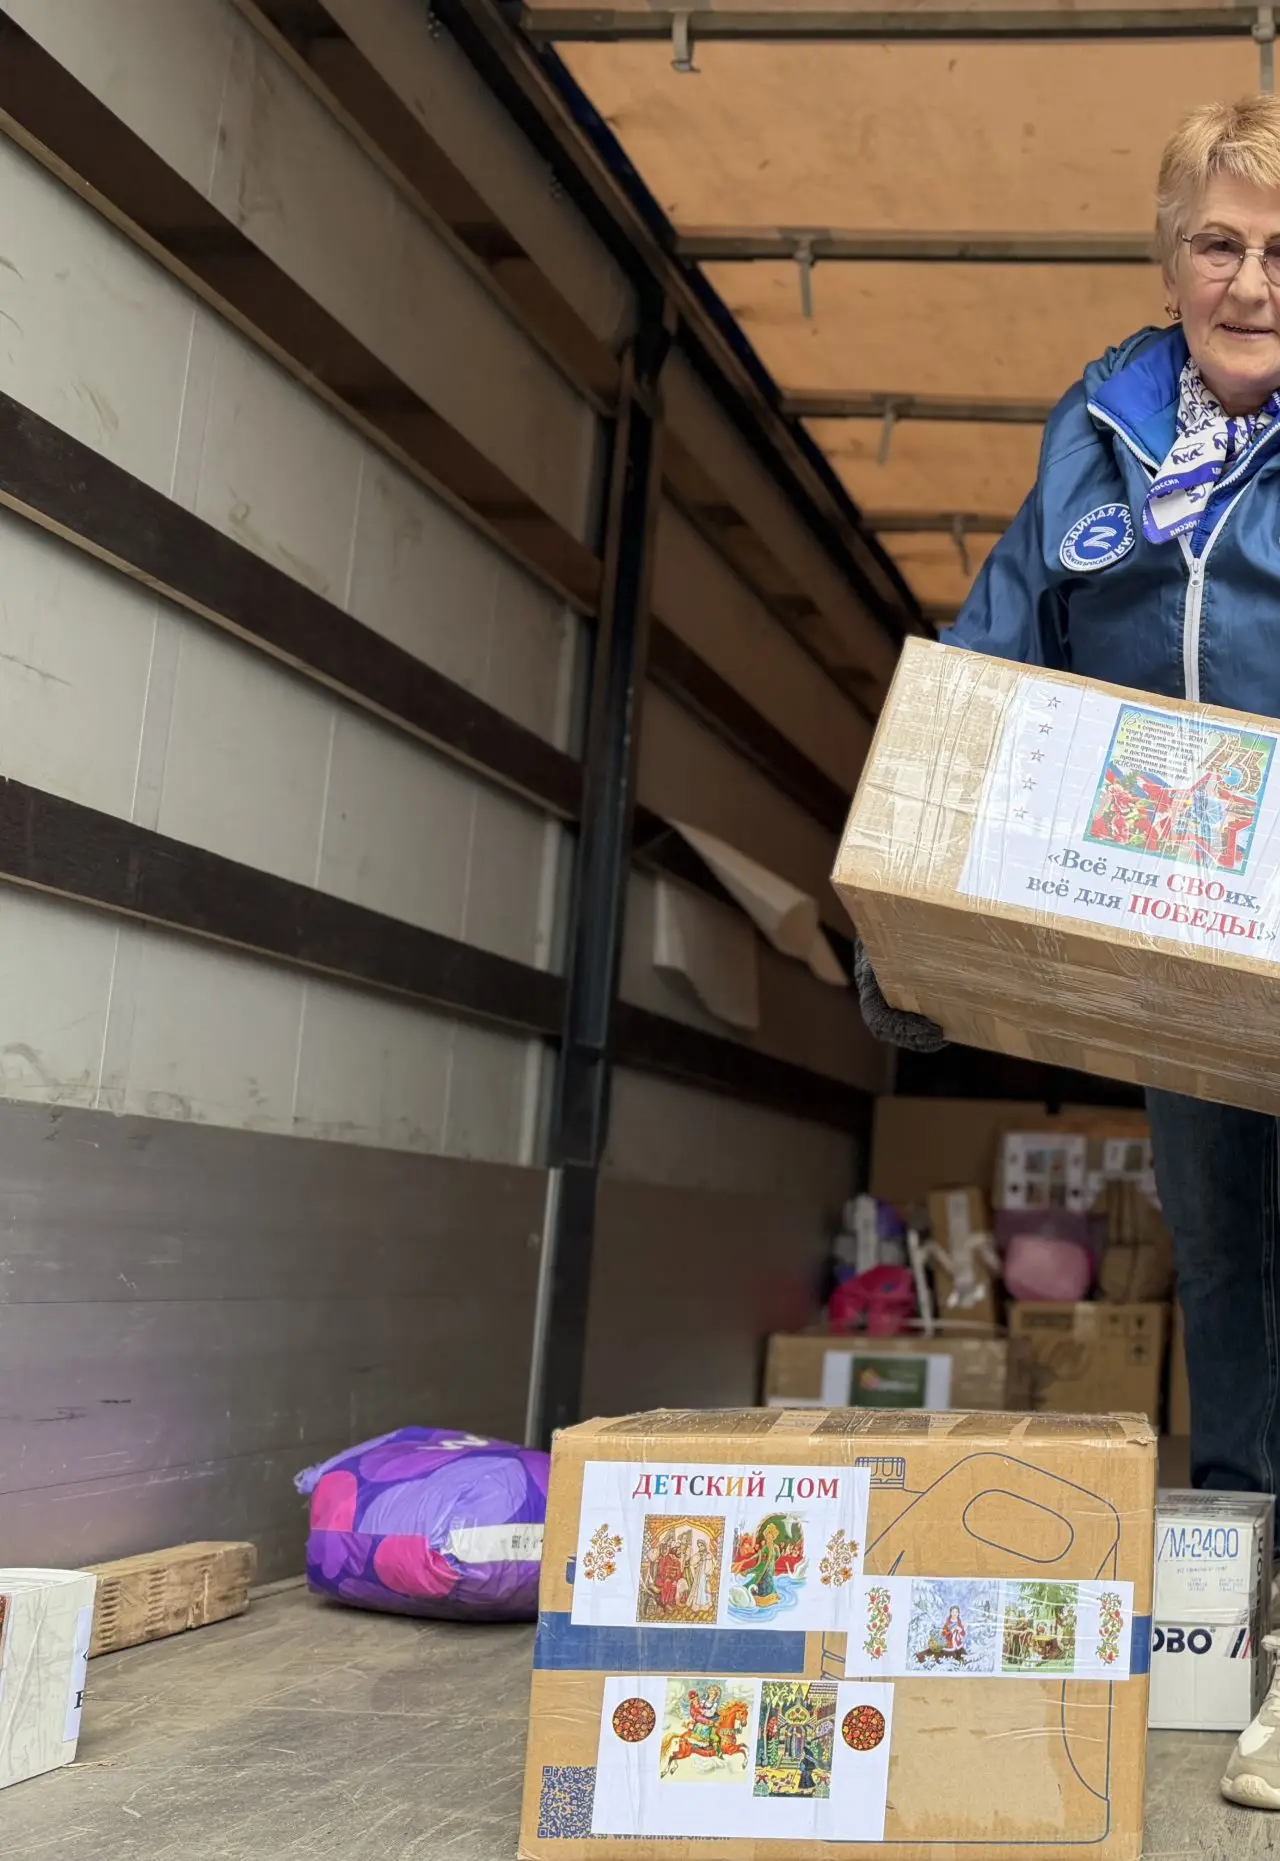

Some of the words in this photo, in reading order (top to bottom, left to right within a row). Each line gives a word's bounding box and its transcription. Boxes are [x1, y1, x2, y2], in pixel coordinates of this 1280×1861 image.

[1064, 507, 1117, 547] ЕДИНАЯ
[1113, 508, 1134, 555] РОССИЯ
[1026, 875, 1069, 897] всё
[1074, 887, 1124, 910] для
[1127, 893, 1277, 942] ПОБЕДЫ!»
[1047, 848, 1107, 875] «Всё
[1111, 865, 1160, 889] для
[1166, 873, 1262, 914] СВОих,
[632, 1470, 767, 1500] ДЕТСКИЙ
[775, 1476, 840, 1503] ДОМ
